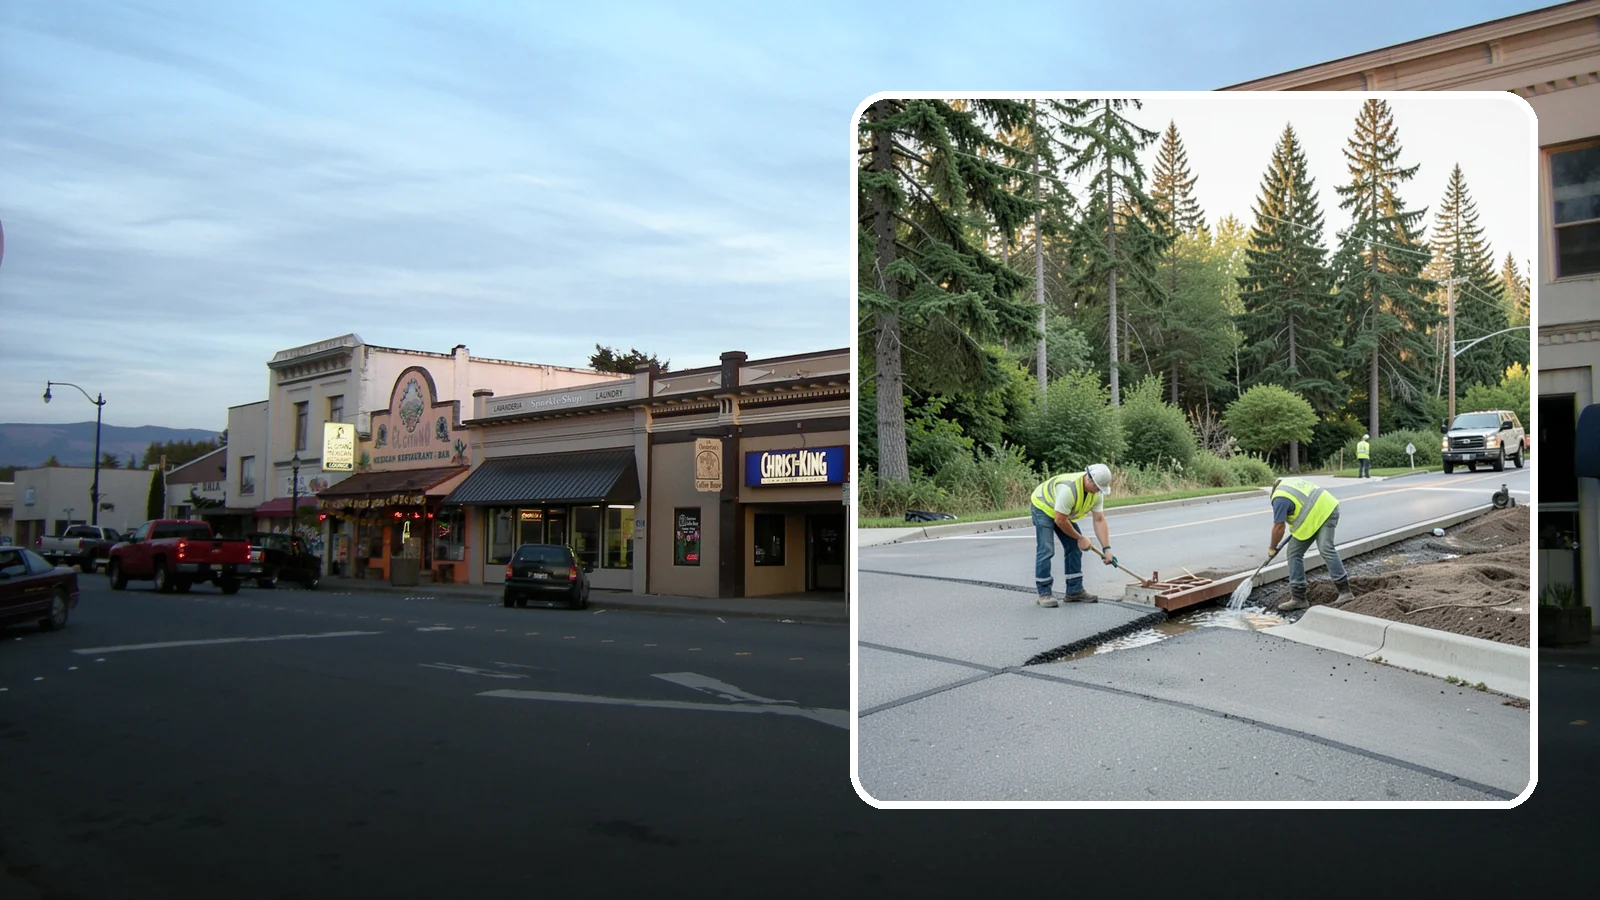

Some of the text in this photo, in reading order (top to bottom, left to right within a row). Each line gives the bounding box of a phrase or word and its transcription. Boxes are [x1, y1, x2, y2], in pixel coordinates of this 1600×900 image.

[493, 389, 623, 412] LAVANDERIA Sparkle Shop LAUNDRY
[373, 455, 396, 464] MEXICAN
[397, 451, 434, 462] RESTAURANT
[438, 450, 450, 459] BAR
[761, 449, 827, 478] CHRIST KING
